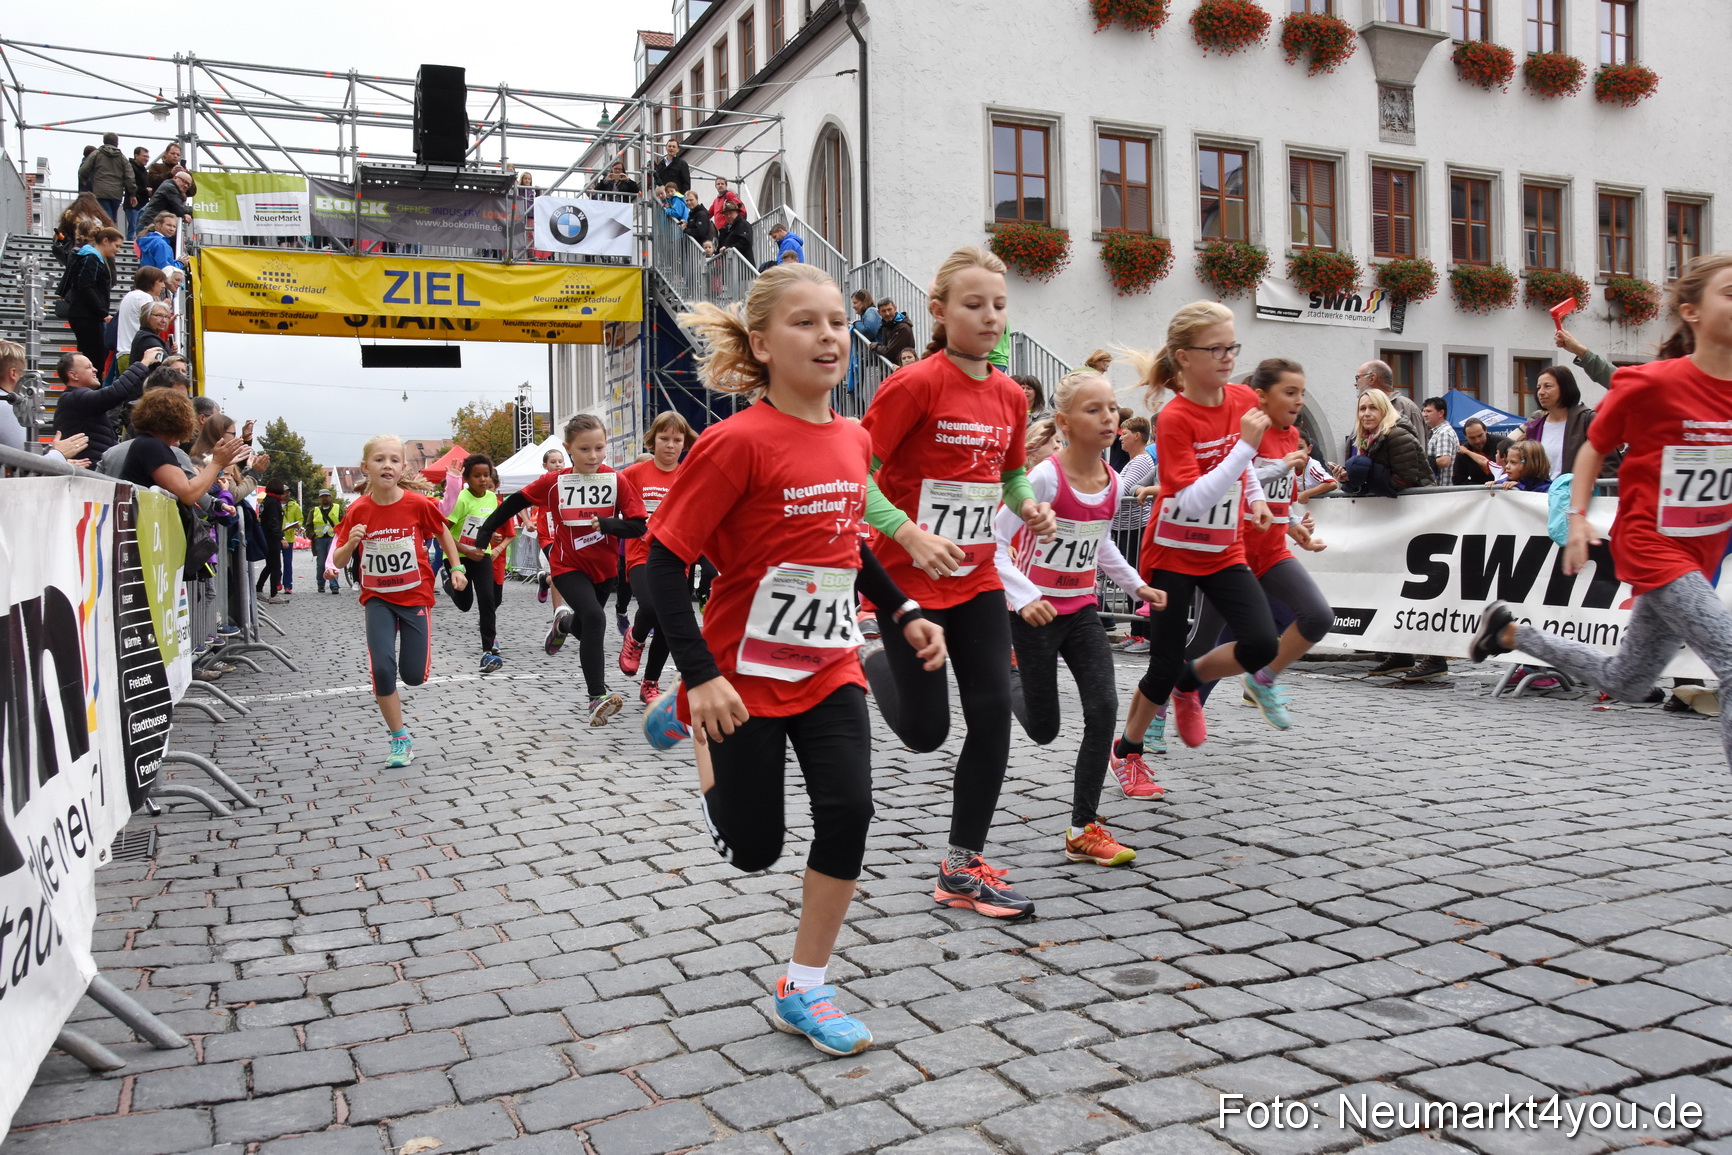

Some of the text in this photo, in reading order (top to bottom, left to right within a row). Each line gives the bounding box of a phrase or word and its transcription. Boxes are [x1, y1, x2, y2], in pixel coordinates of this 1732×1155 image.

[315, 196, 388, 216] BOCK
[397, 205, 430, 214] OFFICE
[432, 207, 479, 217] INDUSTRY
[553, 206, 586, 221] BMW
[253, 214, 301, 222] NeuerMarkt
[416, 219, 502, 232] www.bockonline.de
[226, 280, 326, 294] Neumarkter Stadtlauf
[383, 270, 480, 306] ZIEL
[533, 295, 620, 304] Neumarkter Stadtlauf
[1309, 291, 1362, 312] swn
[228, 308, 318, 320] Neumarkter Stadtlauf
[1307, 310, 1375, 322] stadtwerke neumarkt
[548, 320, 582, 329] Stadtlauf
[935, 420, 994, 434] Neumarkter
[935, 433, 985, 447] Stadtlauf
[564, 485, 612, 506] 7132
[783, 479, 860, 500] Neumarkter
[783, 497, 848, 518] Stadtlauf
[931, 503, 993, 540] 7174
[1044, 538, 1098, 568] 7194
[366, 551, 412, 574] 7092
[1400, 533, 1624, 609] swn
[377, 577, 404, 587] Sophia
[770, 647, 823, 665] Emma
[129, 673, 153, 690] Freizeit
[131, 712, 168, 734] Stadtbusse
